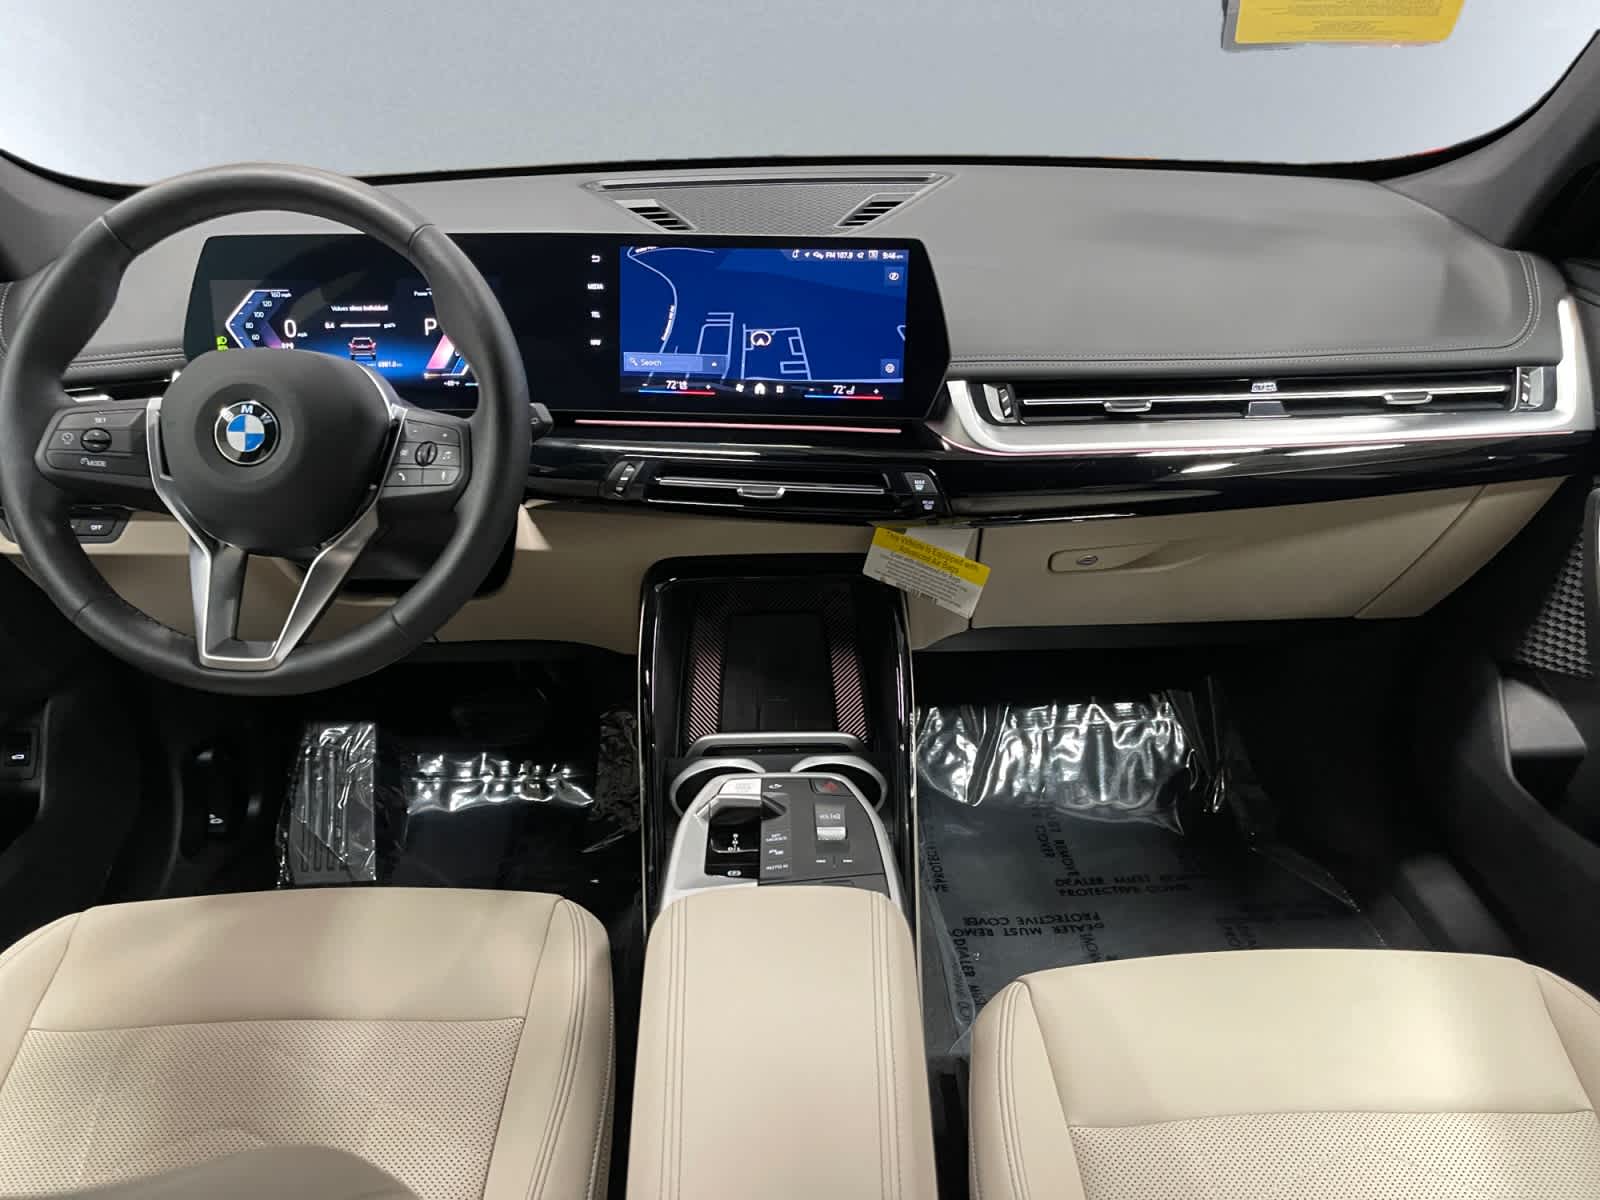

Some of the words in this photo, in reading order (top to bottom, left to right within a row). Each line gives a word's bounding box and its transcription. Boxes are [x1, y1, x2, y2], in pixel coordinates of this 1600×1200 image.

[284, 319, 297, 338] 0
[424, 318, 437, 336] P
[640, 358, 662, 367] Search
[1016, 911, 1102, 926] PROTECTIVE
[1004, 927, 1042, 937] MUST
